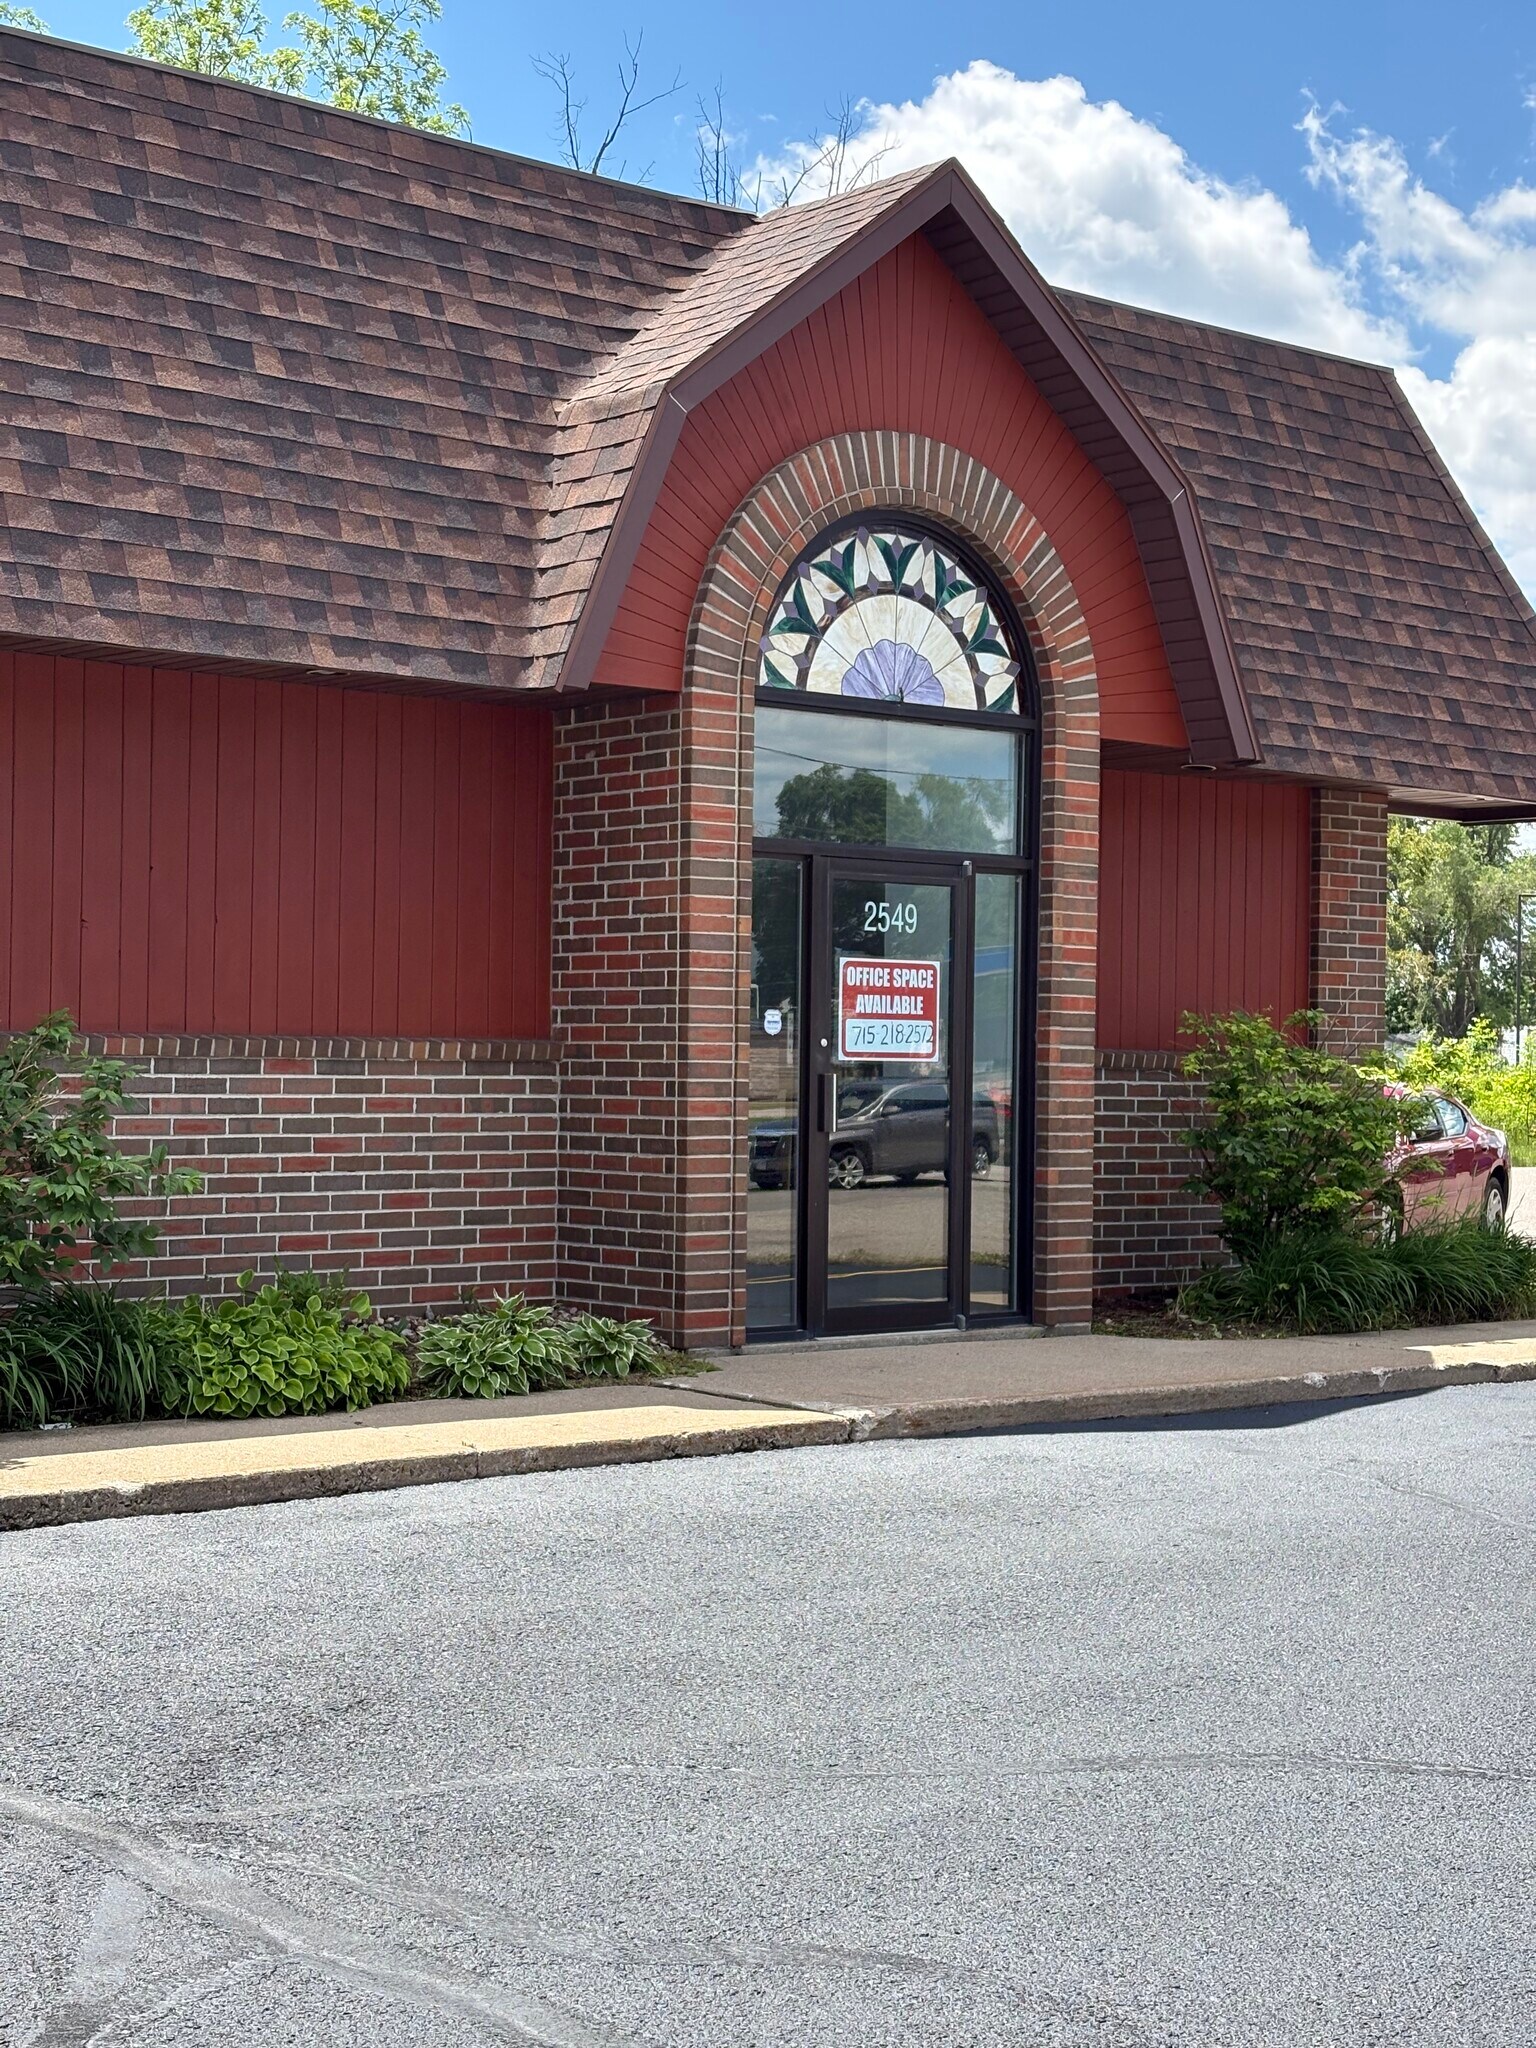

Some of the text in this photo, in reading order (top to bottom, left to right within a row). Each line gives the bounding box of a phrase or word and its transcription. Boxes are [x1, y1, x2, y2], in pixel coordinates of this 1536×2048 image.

[863, 901, 918, 933] 2549
[846, 966, 934, 989] OFFICE SPACE
[855, 994, 924, 1015] AVAILABLE
